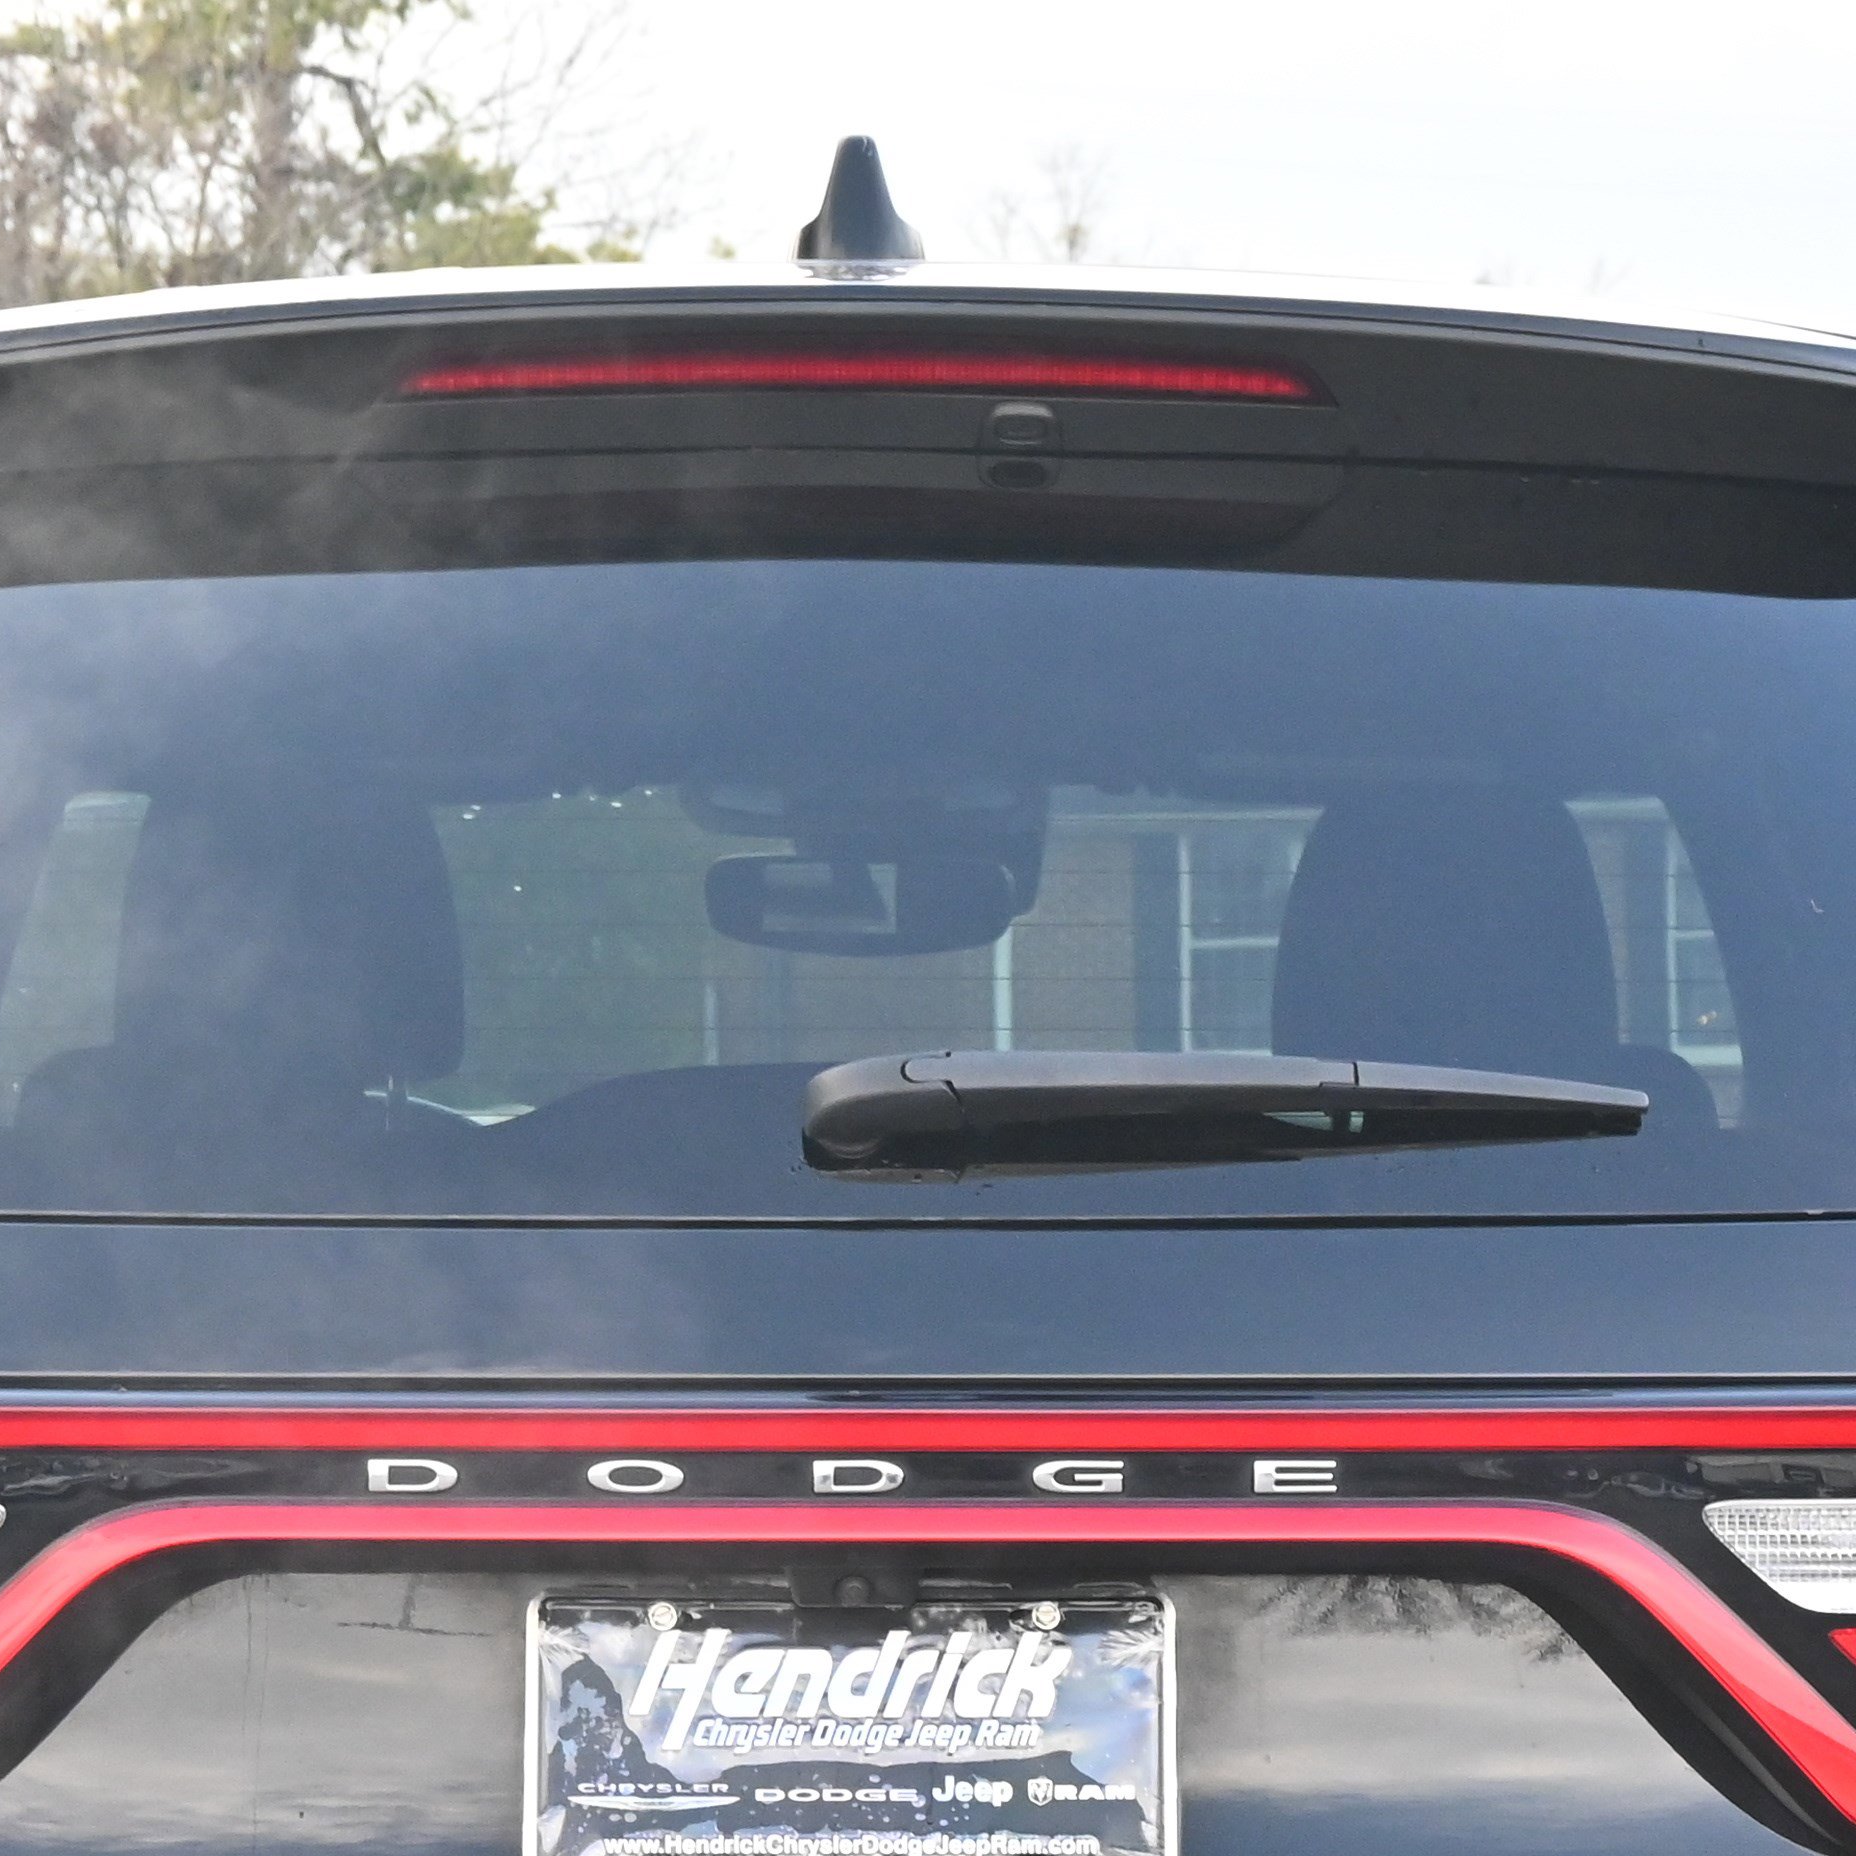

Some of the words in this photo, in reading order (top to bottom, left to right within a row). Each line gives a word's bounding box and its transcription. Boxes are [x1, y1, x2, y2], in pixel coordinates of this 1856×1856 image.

[365, 1458, 1339, 1496] DODGE
[628, 1628, 1073, 1750] Hendrick
[693, 1717, 811, 1755] Chrysler
[811, 1718, 904, 1754] Dodge
[904, 1719, 972, 1753] Jeep
[974, 1718, 1043, 1747] Ram
[576, 1782, 730, 1794] CHRYSLER
[754, 1787, 918, 1803] DODGE
[931, 1774, 1014, 1807] Jeep
[1053, 1783, 1137, 1801] RAM
